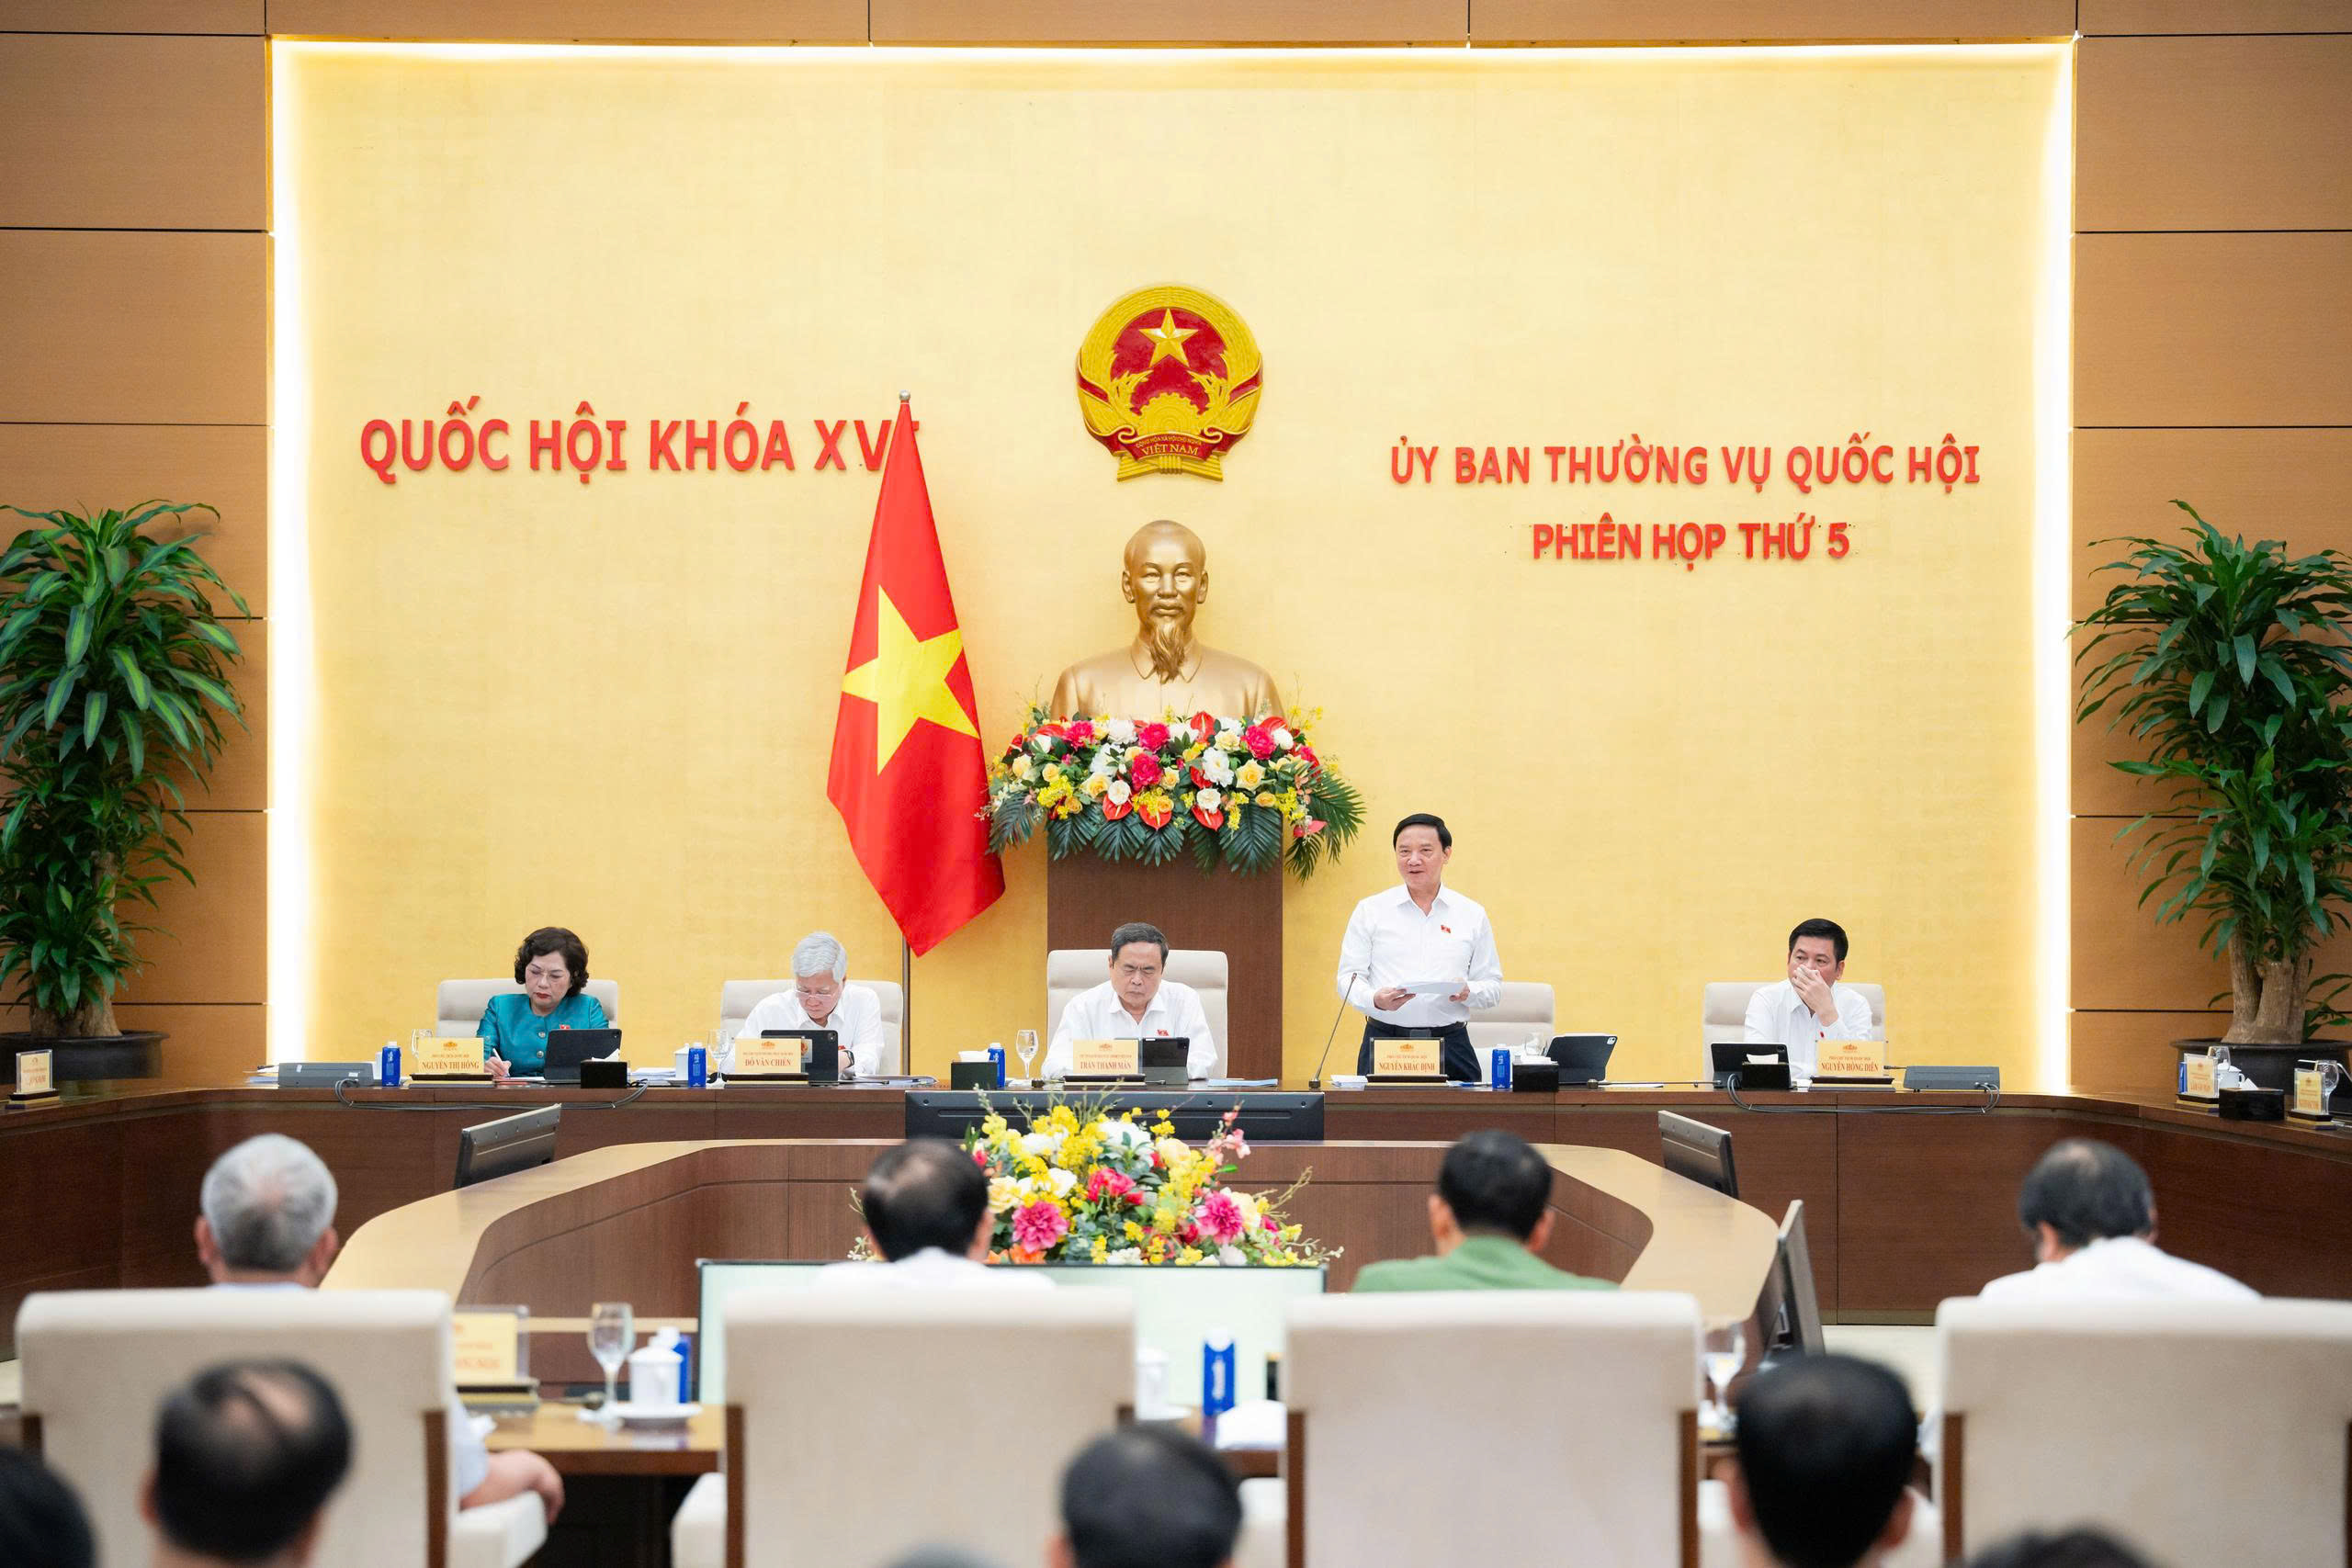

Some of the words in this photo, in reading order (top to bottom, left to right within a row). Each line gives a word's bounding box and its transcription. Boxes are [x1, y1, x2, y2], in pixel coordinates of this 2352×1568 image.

[360, 395, 510, 484] QUỐC
[529, 400, 628, 484] HỘI
[650, 401, 796, 472] KHÓA
[814, 420, 919, 470] XV
[1170, 444, 1198, 456] NAM
[1391, 435, 1440, 484] ỦY
[1454, 446, 1530, 484] BAN
[1544, 433, 1708, 484] THƯỜNG
[1722, 446, 1771, 493] VỤ
[1786, 432, 1894, 494] QUỐC
[1908, 434, 1981, 493] HỘI
[1532, 512, 1643, 559] PHIÊN
[1653, 523, 1726, 571] HỌP
[1737, 512, 1816, 561] THỨ
[1826, 522, 1850, 559] 5
